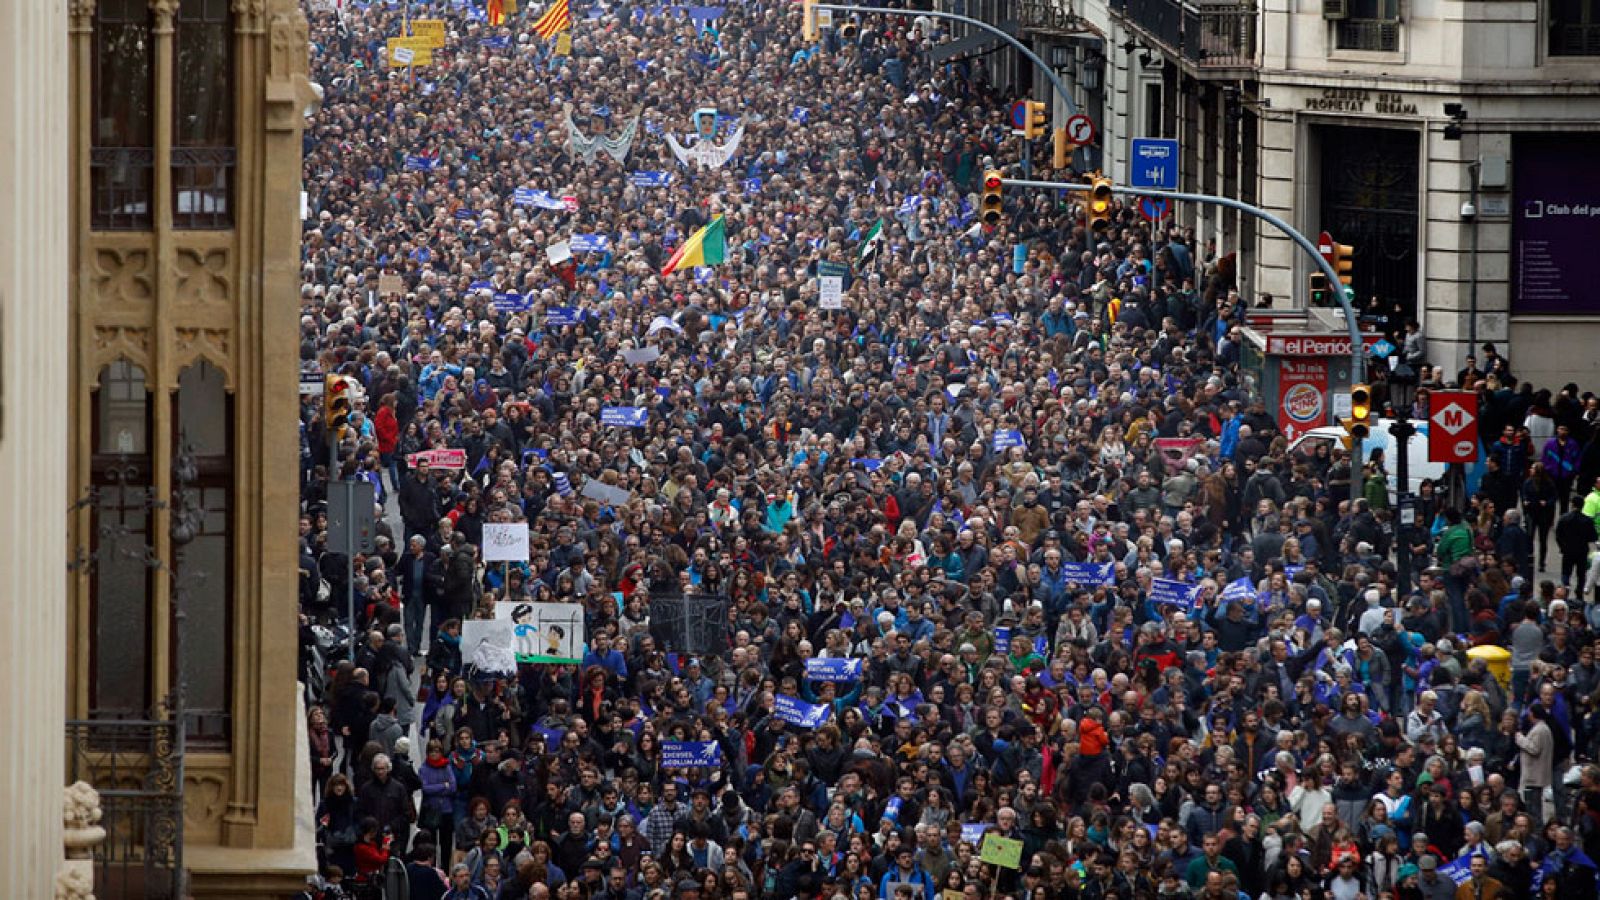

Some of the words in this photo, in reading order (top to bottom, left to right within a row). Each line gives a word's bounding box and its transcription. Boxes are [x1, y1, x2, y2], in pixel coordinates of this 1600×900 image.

[1305, 97, 1364, 112] PROPIETAT
[1375, 102, 1418, 115] URBANA
[1547, 204, 1570, 215] Club
[1572, 204, 1589, 215] del
[1286, 338, 1300, 354] el
[1444, 409, 1462, 427] M
